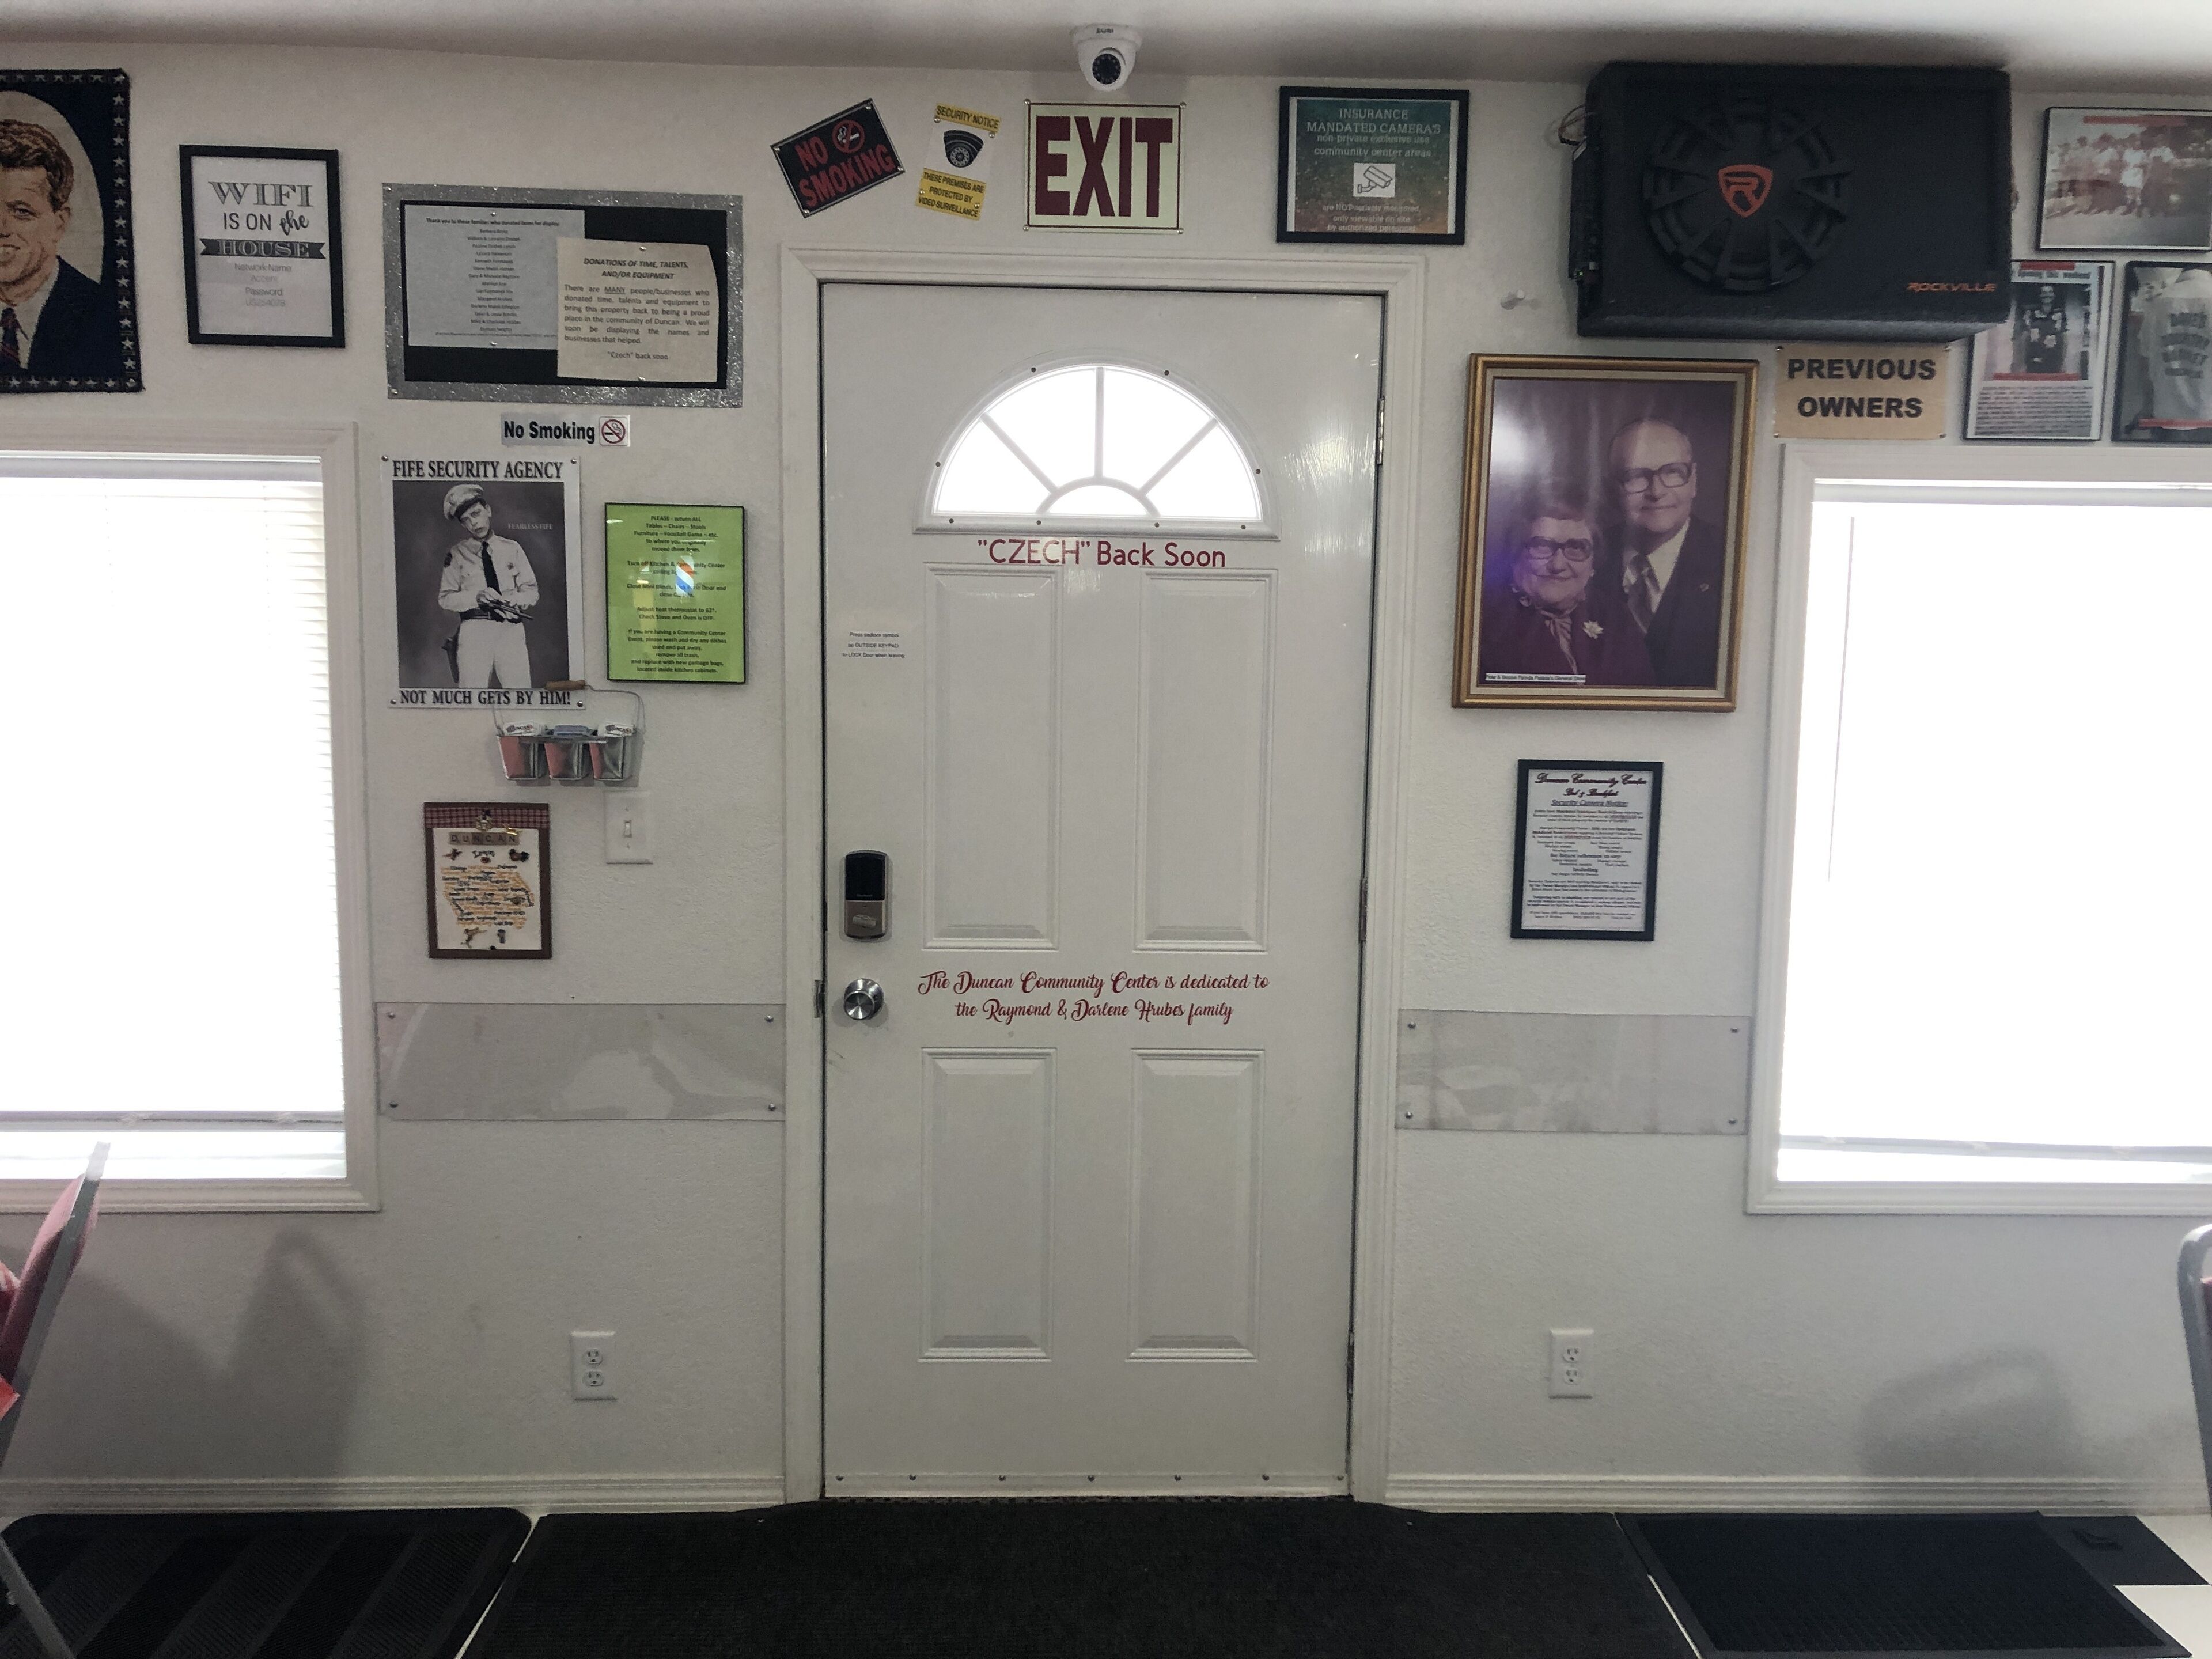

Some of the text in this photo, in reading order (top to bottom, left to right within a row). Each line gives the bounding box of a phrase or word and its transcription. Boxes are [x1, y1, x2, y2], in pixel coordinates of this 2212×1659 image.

[937, 105, 999, 129] SECURITY NOTICE
[1339, 108, 1409, 120] INSURANCE
[1306, 122, 1441, 134] MANDATED CAMERA'S
[794, 136, 829, 172] NO
[1314, 147, 1368, 157] community
[798, 143, 895, 207] SMOKING
[1035, 115, 1173, 217] EXIT
[923, 172, 984, 193] THESE PREMISES ARE
[208, 181, 313, 207] WIFI
[929, 187, 963, 200] PROTECTED
[918, 197, 979, 217] VIDEO SURVEILLANCE
[224, 210, 309, 236] IS ON the
[217, 240, 309, 257] HOUSE
[584, 258, 626, 266] DONATIONS
[640, 260, 658, 268] TIME,
[660, 261, 688, 269] TALENTS,
[245, 287, 283, 296] Password
[605, 286, 626, 294] MANY
[1907, 282, 1997, 293] ROCKVILLE
[565, 305, 582, 313] bring
[565, 316, 582, 324] place
[607, 327, 639, 335] displaying
[1788, 359, 1937, 380] PREVIOUS
[1798, 396, 1923, 418] OWNERS
[504, 421, 595, 445] No Smoking
[393, 460, 564, 479] FIFE SECURITY AGENCY
[978, 539, 1225, 567] "CZECH" Back Soon
[400, 691, 571, 705] NOT MUCH GETS BY HIM!
[1571, 773, 1619, 788] Community
[918, 971, 1270, 998] The Duncan Community Center is dedicated to
[955, 999, 1234, 1026] the Raymond & Darlene Hrubes family
